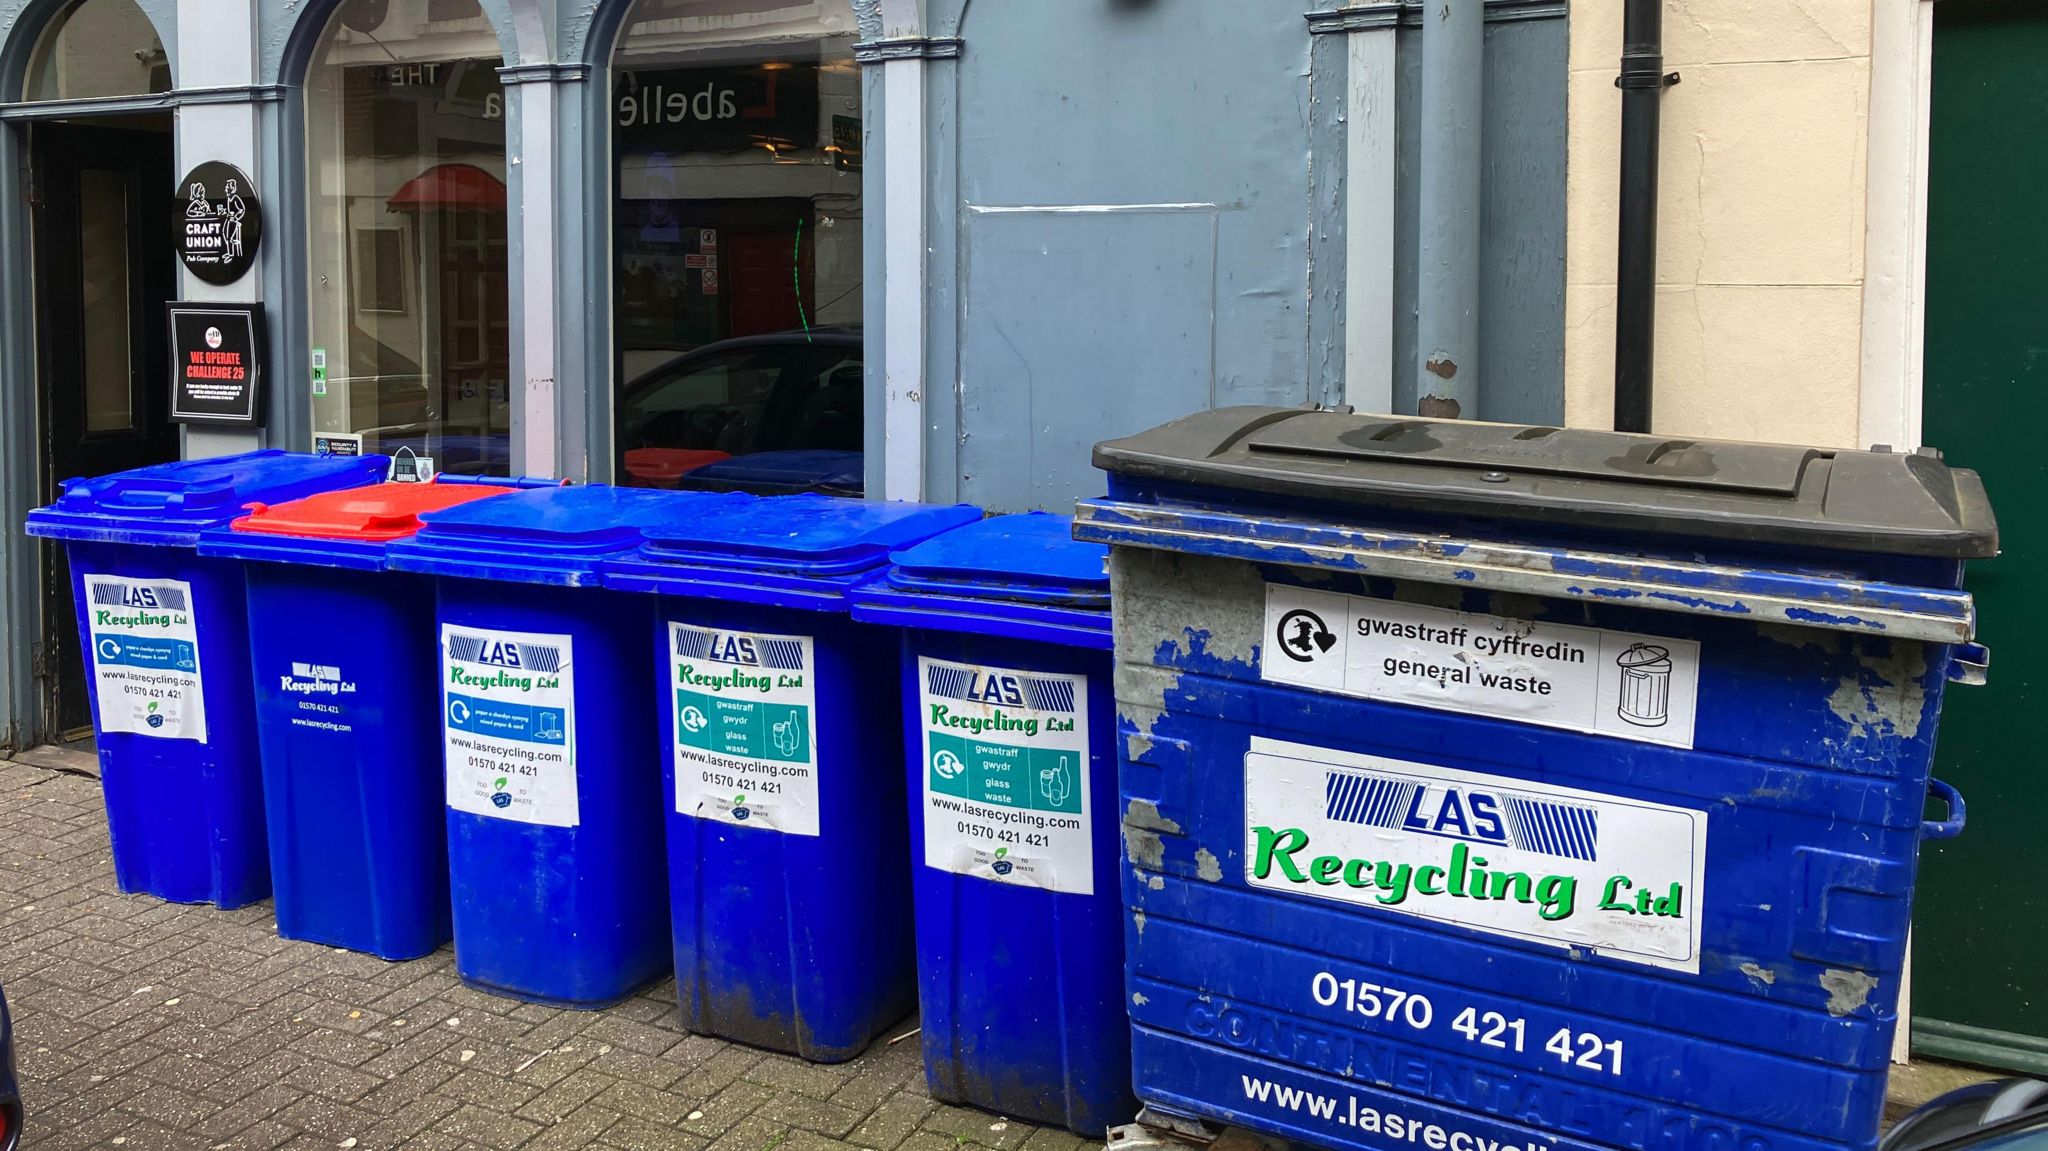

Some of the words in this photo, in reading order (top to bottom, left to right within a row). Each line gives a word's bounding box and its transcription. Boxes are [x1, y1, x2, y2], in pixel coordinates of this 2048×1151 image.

[186, 223, 221, 234] CRAFT
[186, 236, 221, 248] UNION
[197, 255, 219, 263] Company
[190, 351, 204, 364] WE
[205, 351, 241, 365] OPERATE
[186, 365, 232, 379] CHALLENGE
[232, 367, 244, 380] 25
[123, 586, 158, 607] LAS
[96, 610, 170, 629] Recycling
[174, 614, 187, 625] Ltd
[709, 634, 759, 665] LAS
[1357, 616, 1466, 649] gwastraff
[1474, 633, 1585, 664] cyffredin
[478, 640, 521, 666] LAS
[306, 664, 325, 679] LAS
[450, 665, 531, 691] Recycling
[536, 677, 559, 689] Ltd
[678, 663, 771, 693] Recycling
[778, 675, 803, 688] Ltd
[1383, 655, 1472, 685] general
[1479, 673, 1552, 696] waste
[124, 685, 147, 696] 01570
[149, 688, 164, 698] 421
[167, 690, 182, 699] 421
[280, 676, 338, 695] Recycling
[340, 681, 356, 692] Ltd
[966, 670, 1024, 705] LAS
[298, 701, 316, 710] 01570
[316, 704, 327, 712] 421
[328, 705, 339, 714] 421
[716, 700, 754, 712] gwastraff
[723, 714, 748, 726] gwydr
[930, 703, 1038, 736] Recycling
[1045, 717, 1074, 731] Ltd
[725, 731, 747, 741] glass
[451, 736, 562, 762] www.lasrecycling.com
[725, 744, 749, 755] waste
[975, 744, 1018, 758] gwastraff
[468, 756, 496, 770] 01570
[498, 762, 516, 774] 421
[519, 765, 538, 777] 421
[680, 749, 809, 778] www.lasrecycling.com
[982, 759, 1012, 773] gwydr
[702, 771, 734, 788] 01570
[737, 779, 756, 791] 421
[760, 782, 781, 794] 421
[985, 777, 1010, 789] glass
[984, 792, 1012, 804] waste
[931, 796, 1080, 829] www.lasrecycling.com
[1402, 782, 1510, 842] LAS
[957, 820, 994, 839] 01570
[997, 829, 1020, 844] 421
[1025, 833, 1049, 847] 421
[1250, 825, 1578, 920] Recycling
[1597, 875, 1684, 918] Ltd
[1312, 971, 1433, 1029] 01570
[1452, 1007, 1525, 1052] 421
[1545, 1028, 1623, 1076] 421
[1185, 1000, 1592, 1136] CONTINENTAL
